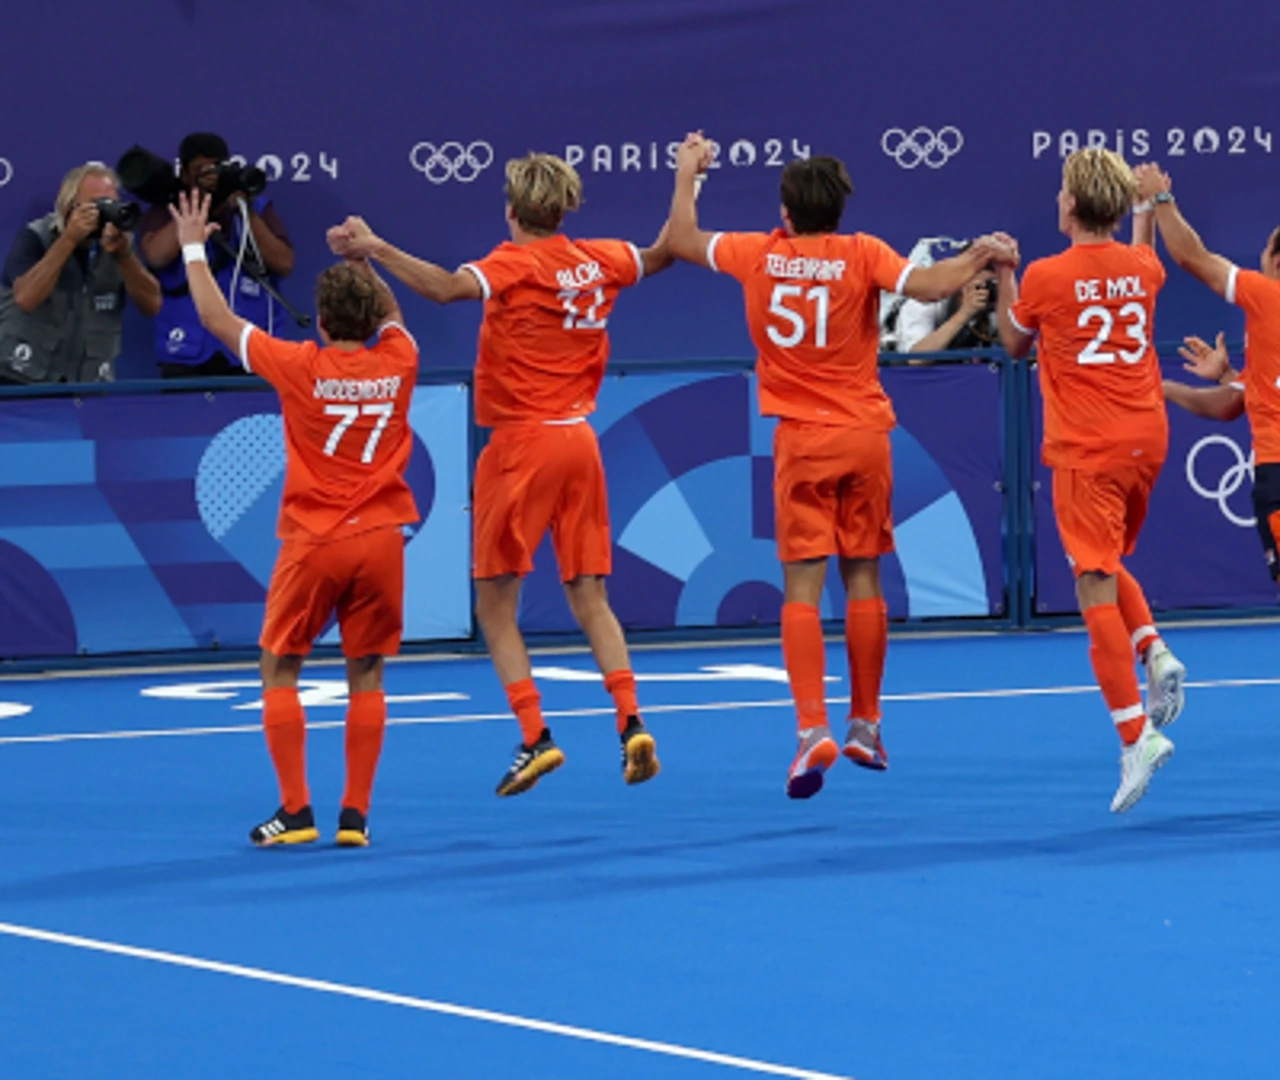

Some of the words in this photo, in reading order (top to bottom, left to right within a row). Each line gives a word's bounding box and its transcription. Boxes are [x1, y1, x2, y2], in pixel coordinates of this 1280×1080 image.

[565, 142, 681, 172] PARIS
[1032, 128, 1150, 159] PARIS
[1167, 125, 1272, 156] 2024
[1075, 278, 1102, 303] DE
[1106, 275, 1147, 301] MOL
[766, 282, 830, 350] 51
[1078, 301, 1149, 365] 23
[322, 401, 395, 464] 77
